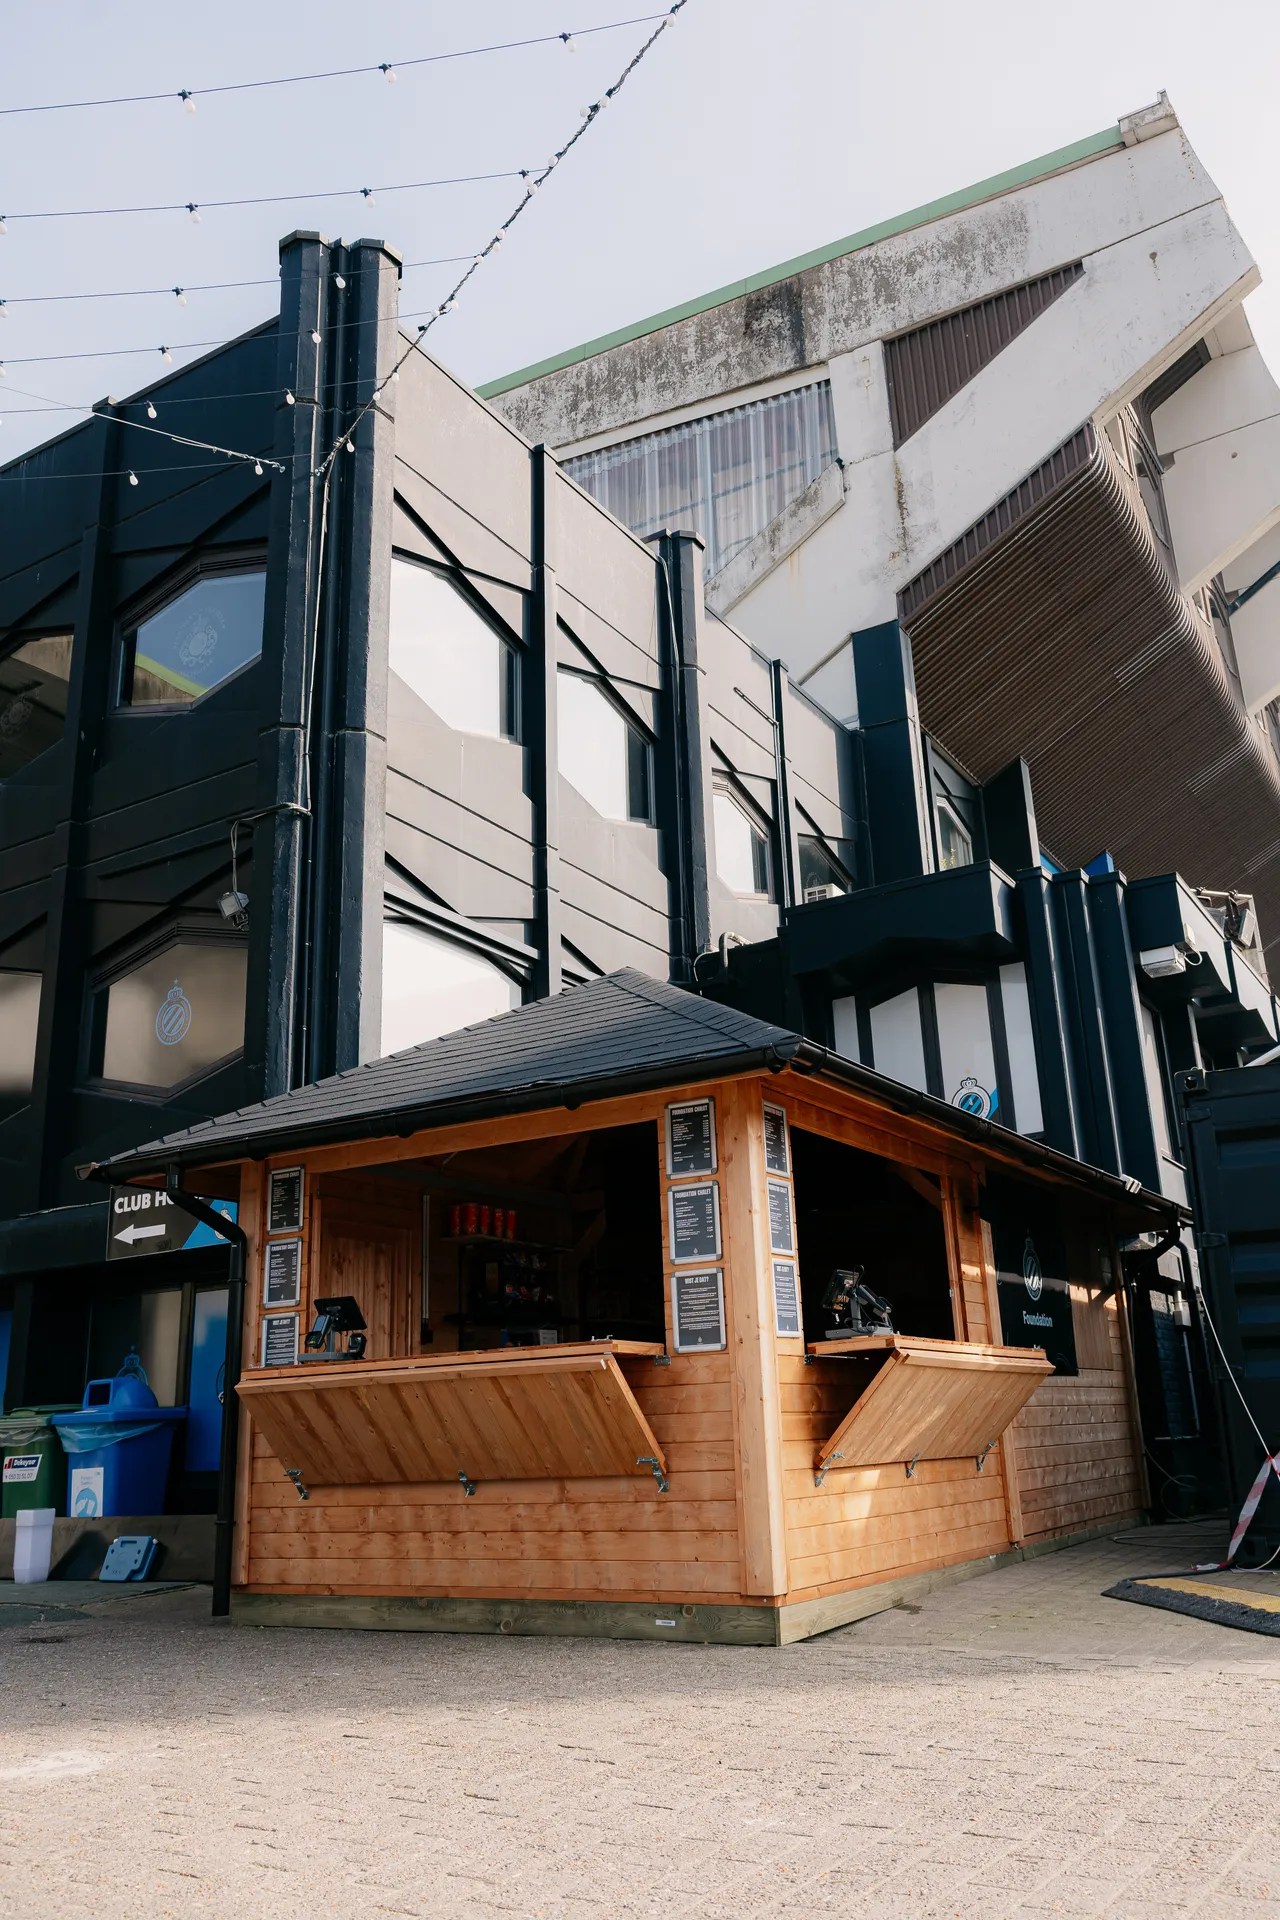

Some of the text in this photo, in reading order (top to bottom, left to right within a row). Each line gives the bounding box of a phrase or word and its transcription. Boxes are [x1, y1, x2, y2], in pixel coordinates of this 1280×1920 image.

[674, 1188, 711, 1199] FOUNDATION CHALET
[114, 1193, 151, 1214] CLUB
[1022, 1310, 1053, 1327] Foundation
